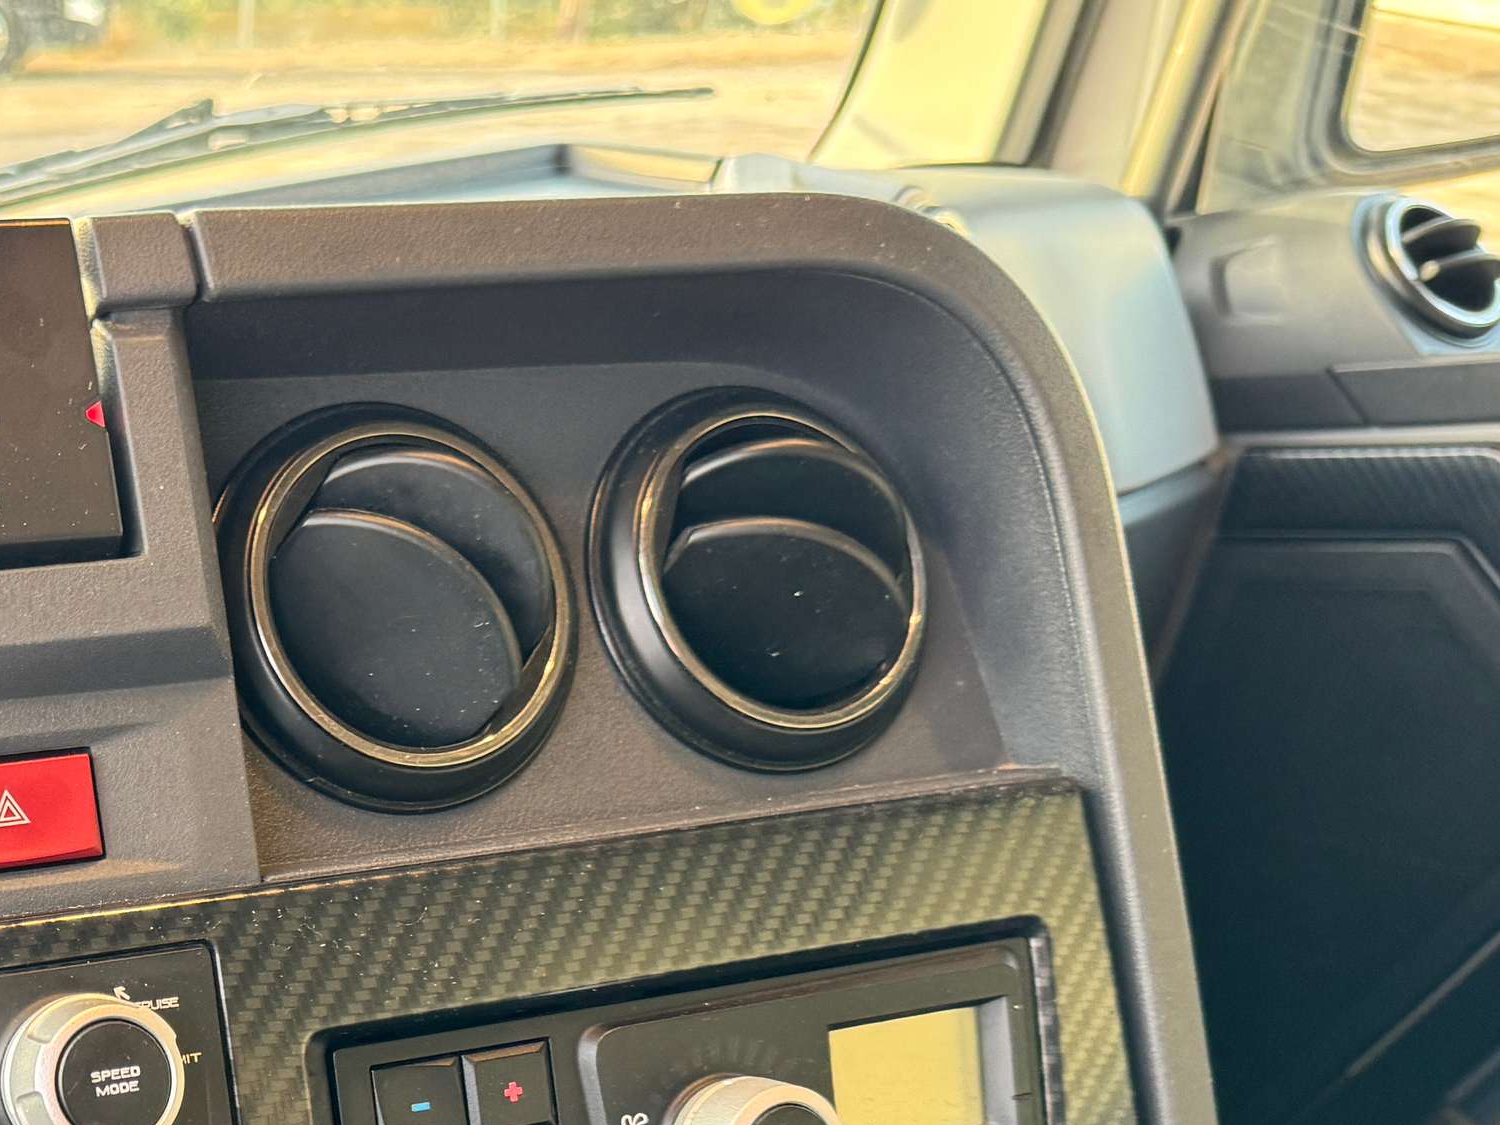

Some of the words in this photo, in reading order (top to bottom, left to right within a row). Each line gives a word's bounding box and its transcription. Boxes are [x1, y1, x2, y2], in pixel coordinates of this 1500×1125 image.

[135, 997, 180, 1010] RUISE
[90, 1065, 141, 1084] SPEED
[95, 1080, 140, 1098] MODE
